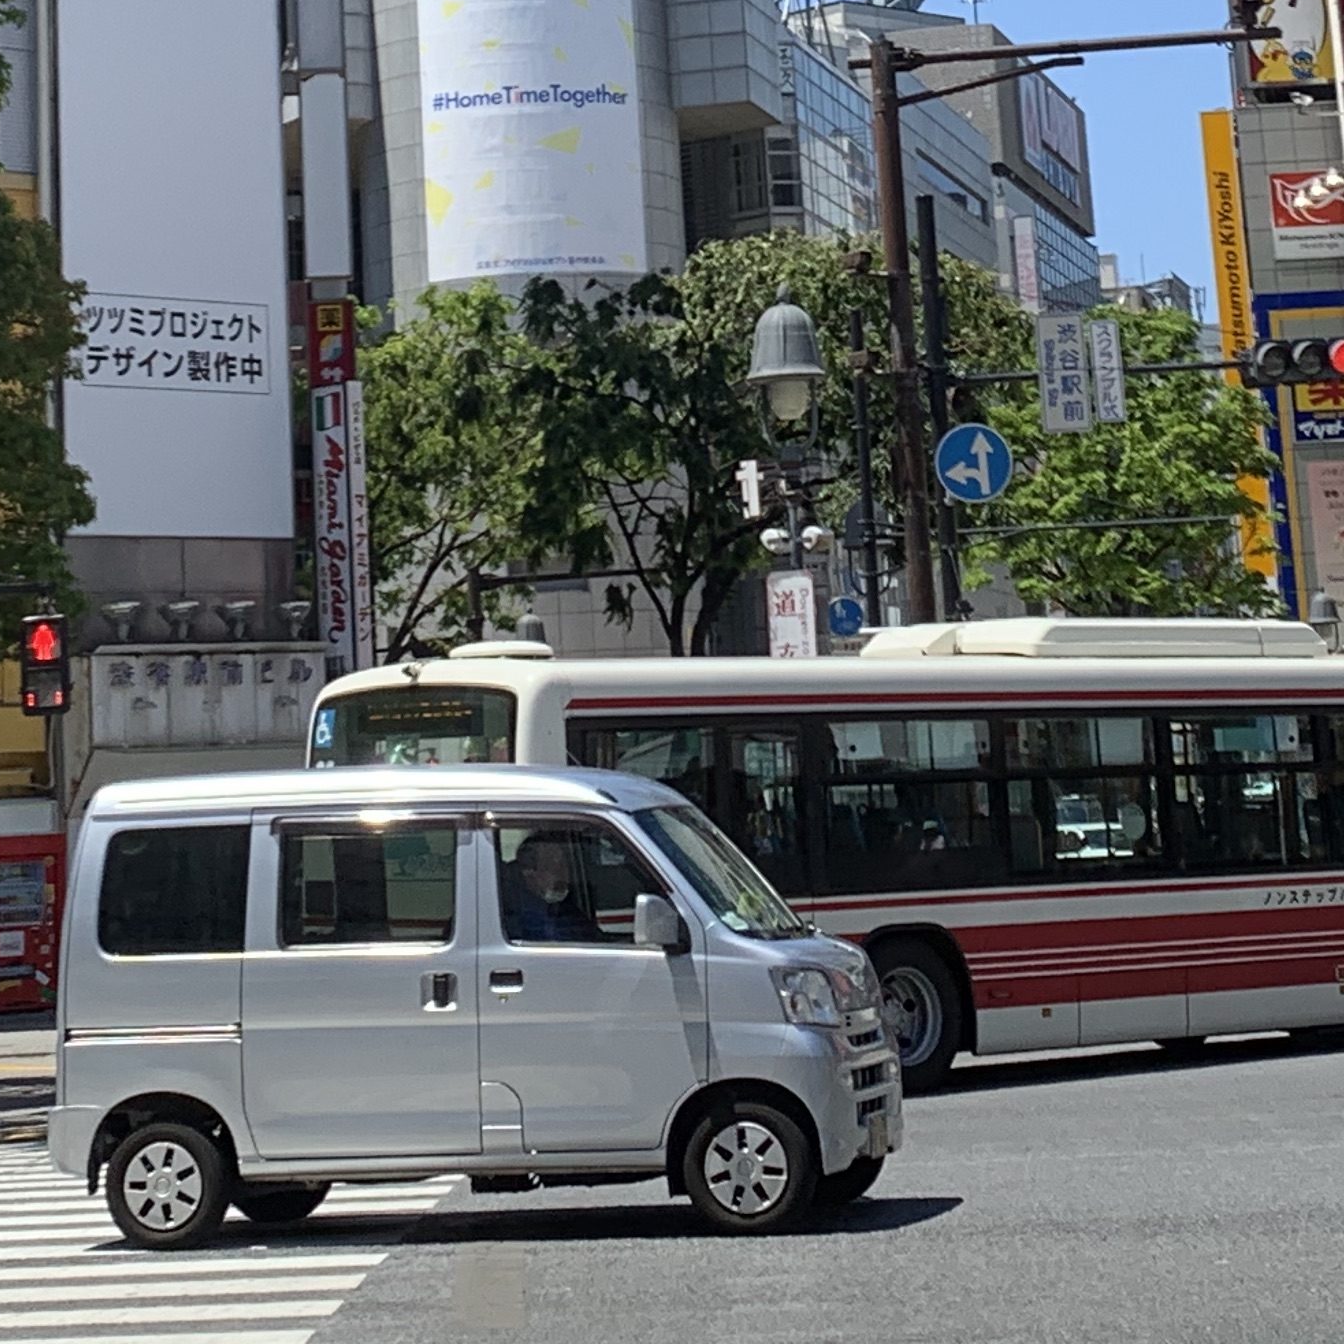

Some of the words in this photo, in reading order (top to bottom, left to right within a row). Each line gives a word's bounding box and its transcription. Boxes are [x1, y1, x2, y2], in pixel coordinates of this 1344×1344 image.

[432, 82, 629, 112] #HomeTimeTogether
[1219, 171, 1240, 248] KiYoshi
[86, 305, 263, 344] ツツミプロジェクト
[86, 345, 264, 385] デザイン製作中
[1056, 323, 1084, 422] 渋谷駅前
[1096, 324, 1120, 418] スクランブル式
